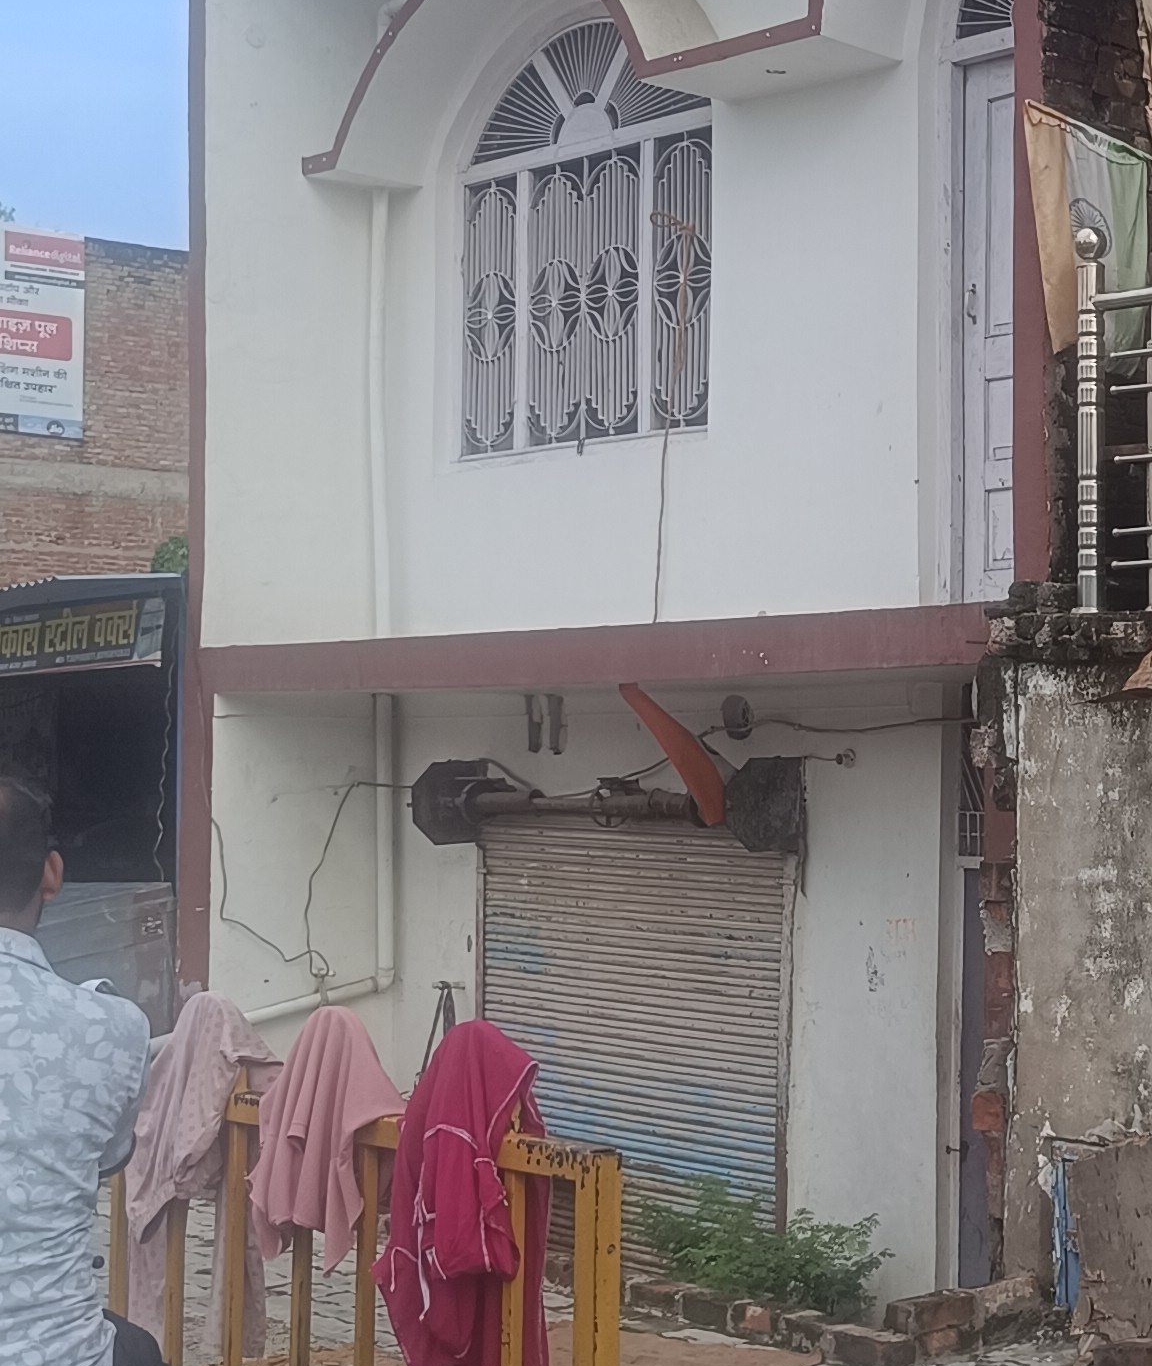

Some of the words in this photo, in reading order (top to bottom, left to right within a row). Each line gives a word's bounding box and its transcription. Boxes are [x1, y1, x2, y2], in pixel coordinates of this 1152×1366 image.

[34, 321, 58, 339] पूल
[0, 332, 38, 353] शिप्स
[53, 367, 68, 381] की
[0, 621, 42, 658] कास
[44, 608, 91, 653] स्टील
[94, 599, 138, 647] वर्क्स
